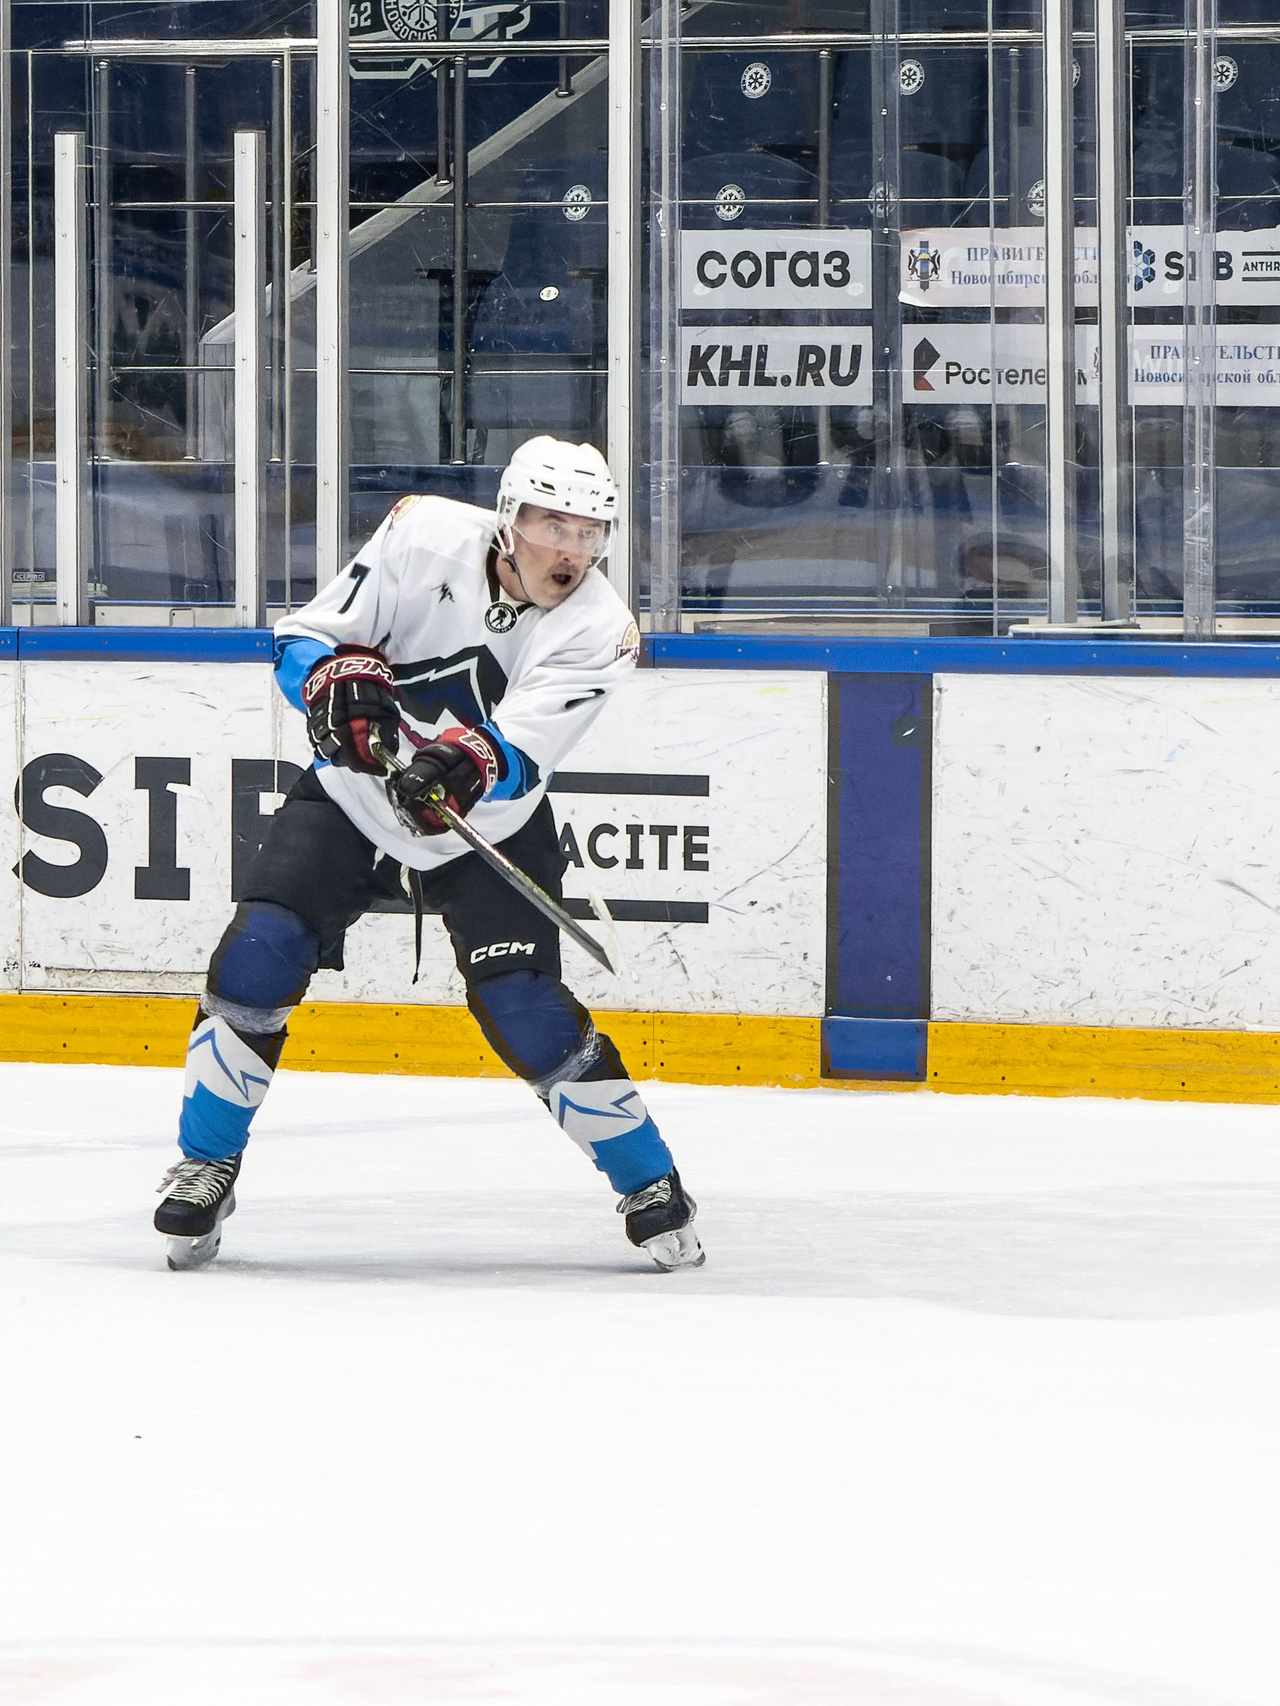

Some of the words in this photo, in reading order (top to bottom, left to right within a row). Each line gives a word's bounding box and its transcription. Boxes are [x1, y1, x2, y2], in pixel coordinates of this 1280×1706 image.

[687, 344, 862, 387] KHL.RU
[337, 562, 371, 614] 7
[305, 656, 394, 700] CCM
[470, 942, 536, 965] CCM
